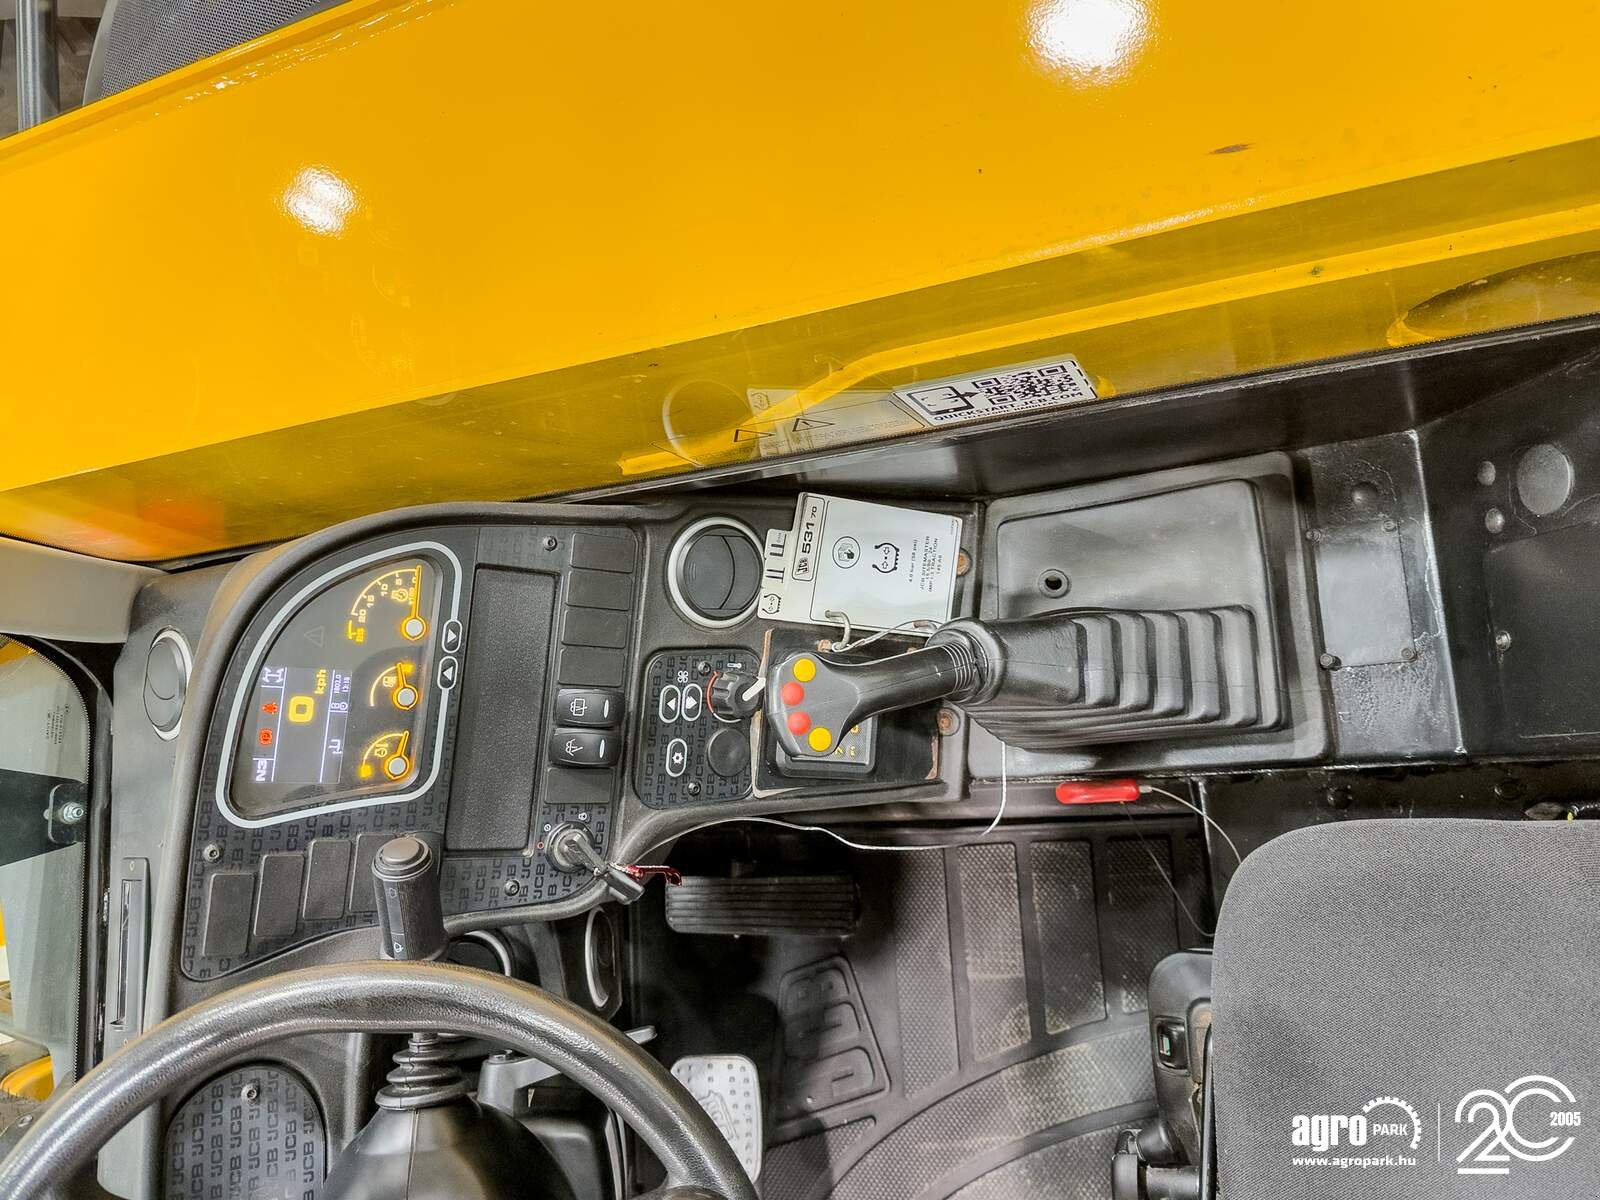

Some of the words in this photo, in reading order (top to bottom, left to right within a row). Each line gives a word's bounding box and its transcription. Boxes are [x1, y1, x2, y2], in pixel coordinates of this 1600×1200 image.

[933, 390, 1084, 422] QUICKSTART.JCB.COM
[810, 506, 817, 519] 70
[801, 520, 814, 554] 531
[797, 558, 809, 573] JCB
[921, 536, 930, 576] SITEMASTER
[380, 583, 388, 597] 10
[395, 578, 402, 586] 5
[358, 609, 367, 623] 20
[366, 595, 375, 608] 15
[314, 668, 327, 695] kph
[287, 695, 314, 723] 0
[255, 759, 268, 782] N3
[533, 863, 546, 900] JCB
[211, 1083, 224, 1128] JCB
[266, 1099, 279, 1142] JCB
[191, 1111, 205, 1157] JCB
[230, 1105, 242, 1149] JCB
[284, 1119, 297, 1162] JCB
[210, 1134, 223, 1178] JCB
[249, 1126, 261, 1170] JCB
[302, 1140, 315, 1183] JCB
